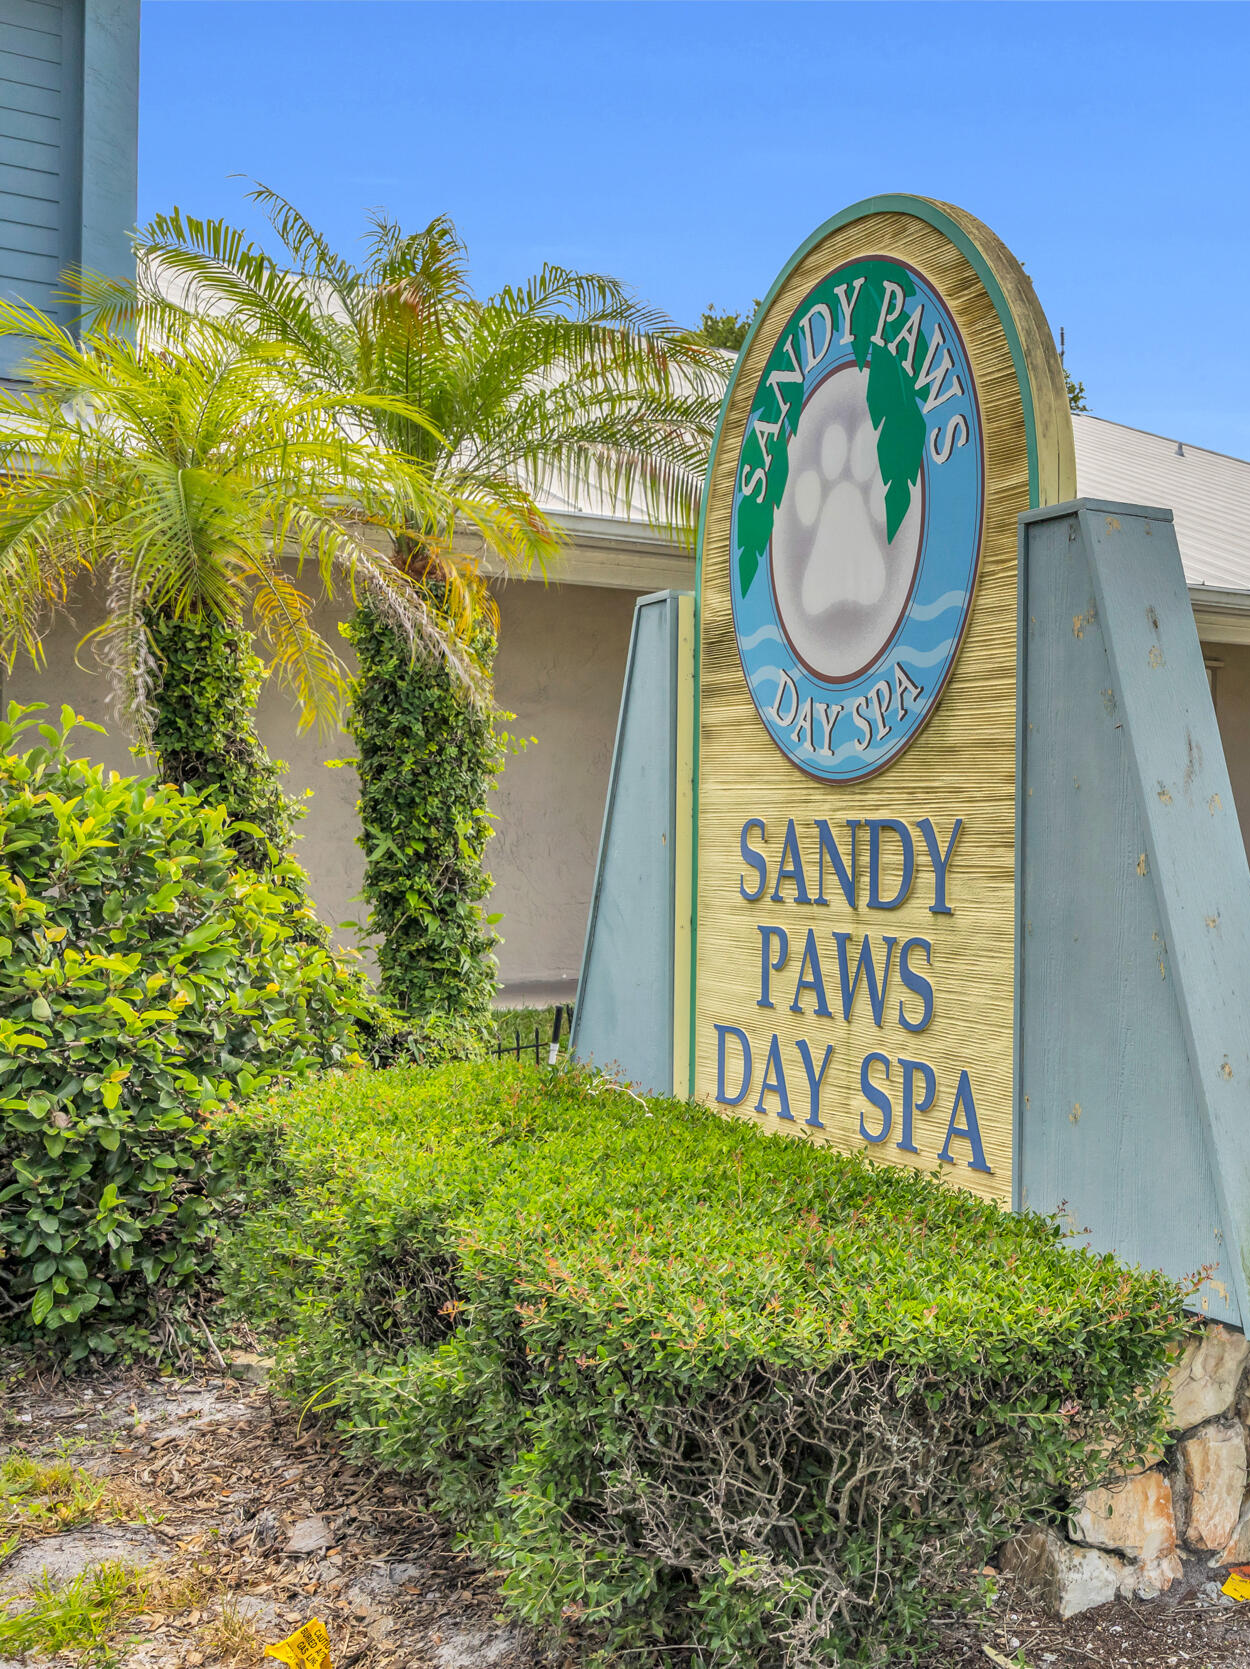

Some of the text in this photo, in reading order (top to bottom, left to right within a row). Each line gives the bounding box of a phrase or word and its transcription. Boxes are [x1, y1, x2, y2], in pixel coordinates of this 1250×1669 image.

[742, 276, 970, 504] SANDY PAWS
[768, 662, 922, 757] DAY SPA
[739, 817, 964, 914] SANDY
[756, 925, 935, 1033] PAWS
[714, 1023, 992, 1173] DAY SPA
[297, 1641, 309, 1655] GAS
[300, 1628, 317, 1648] BURIED
